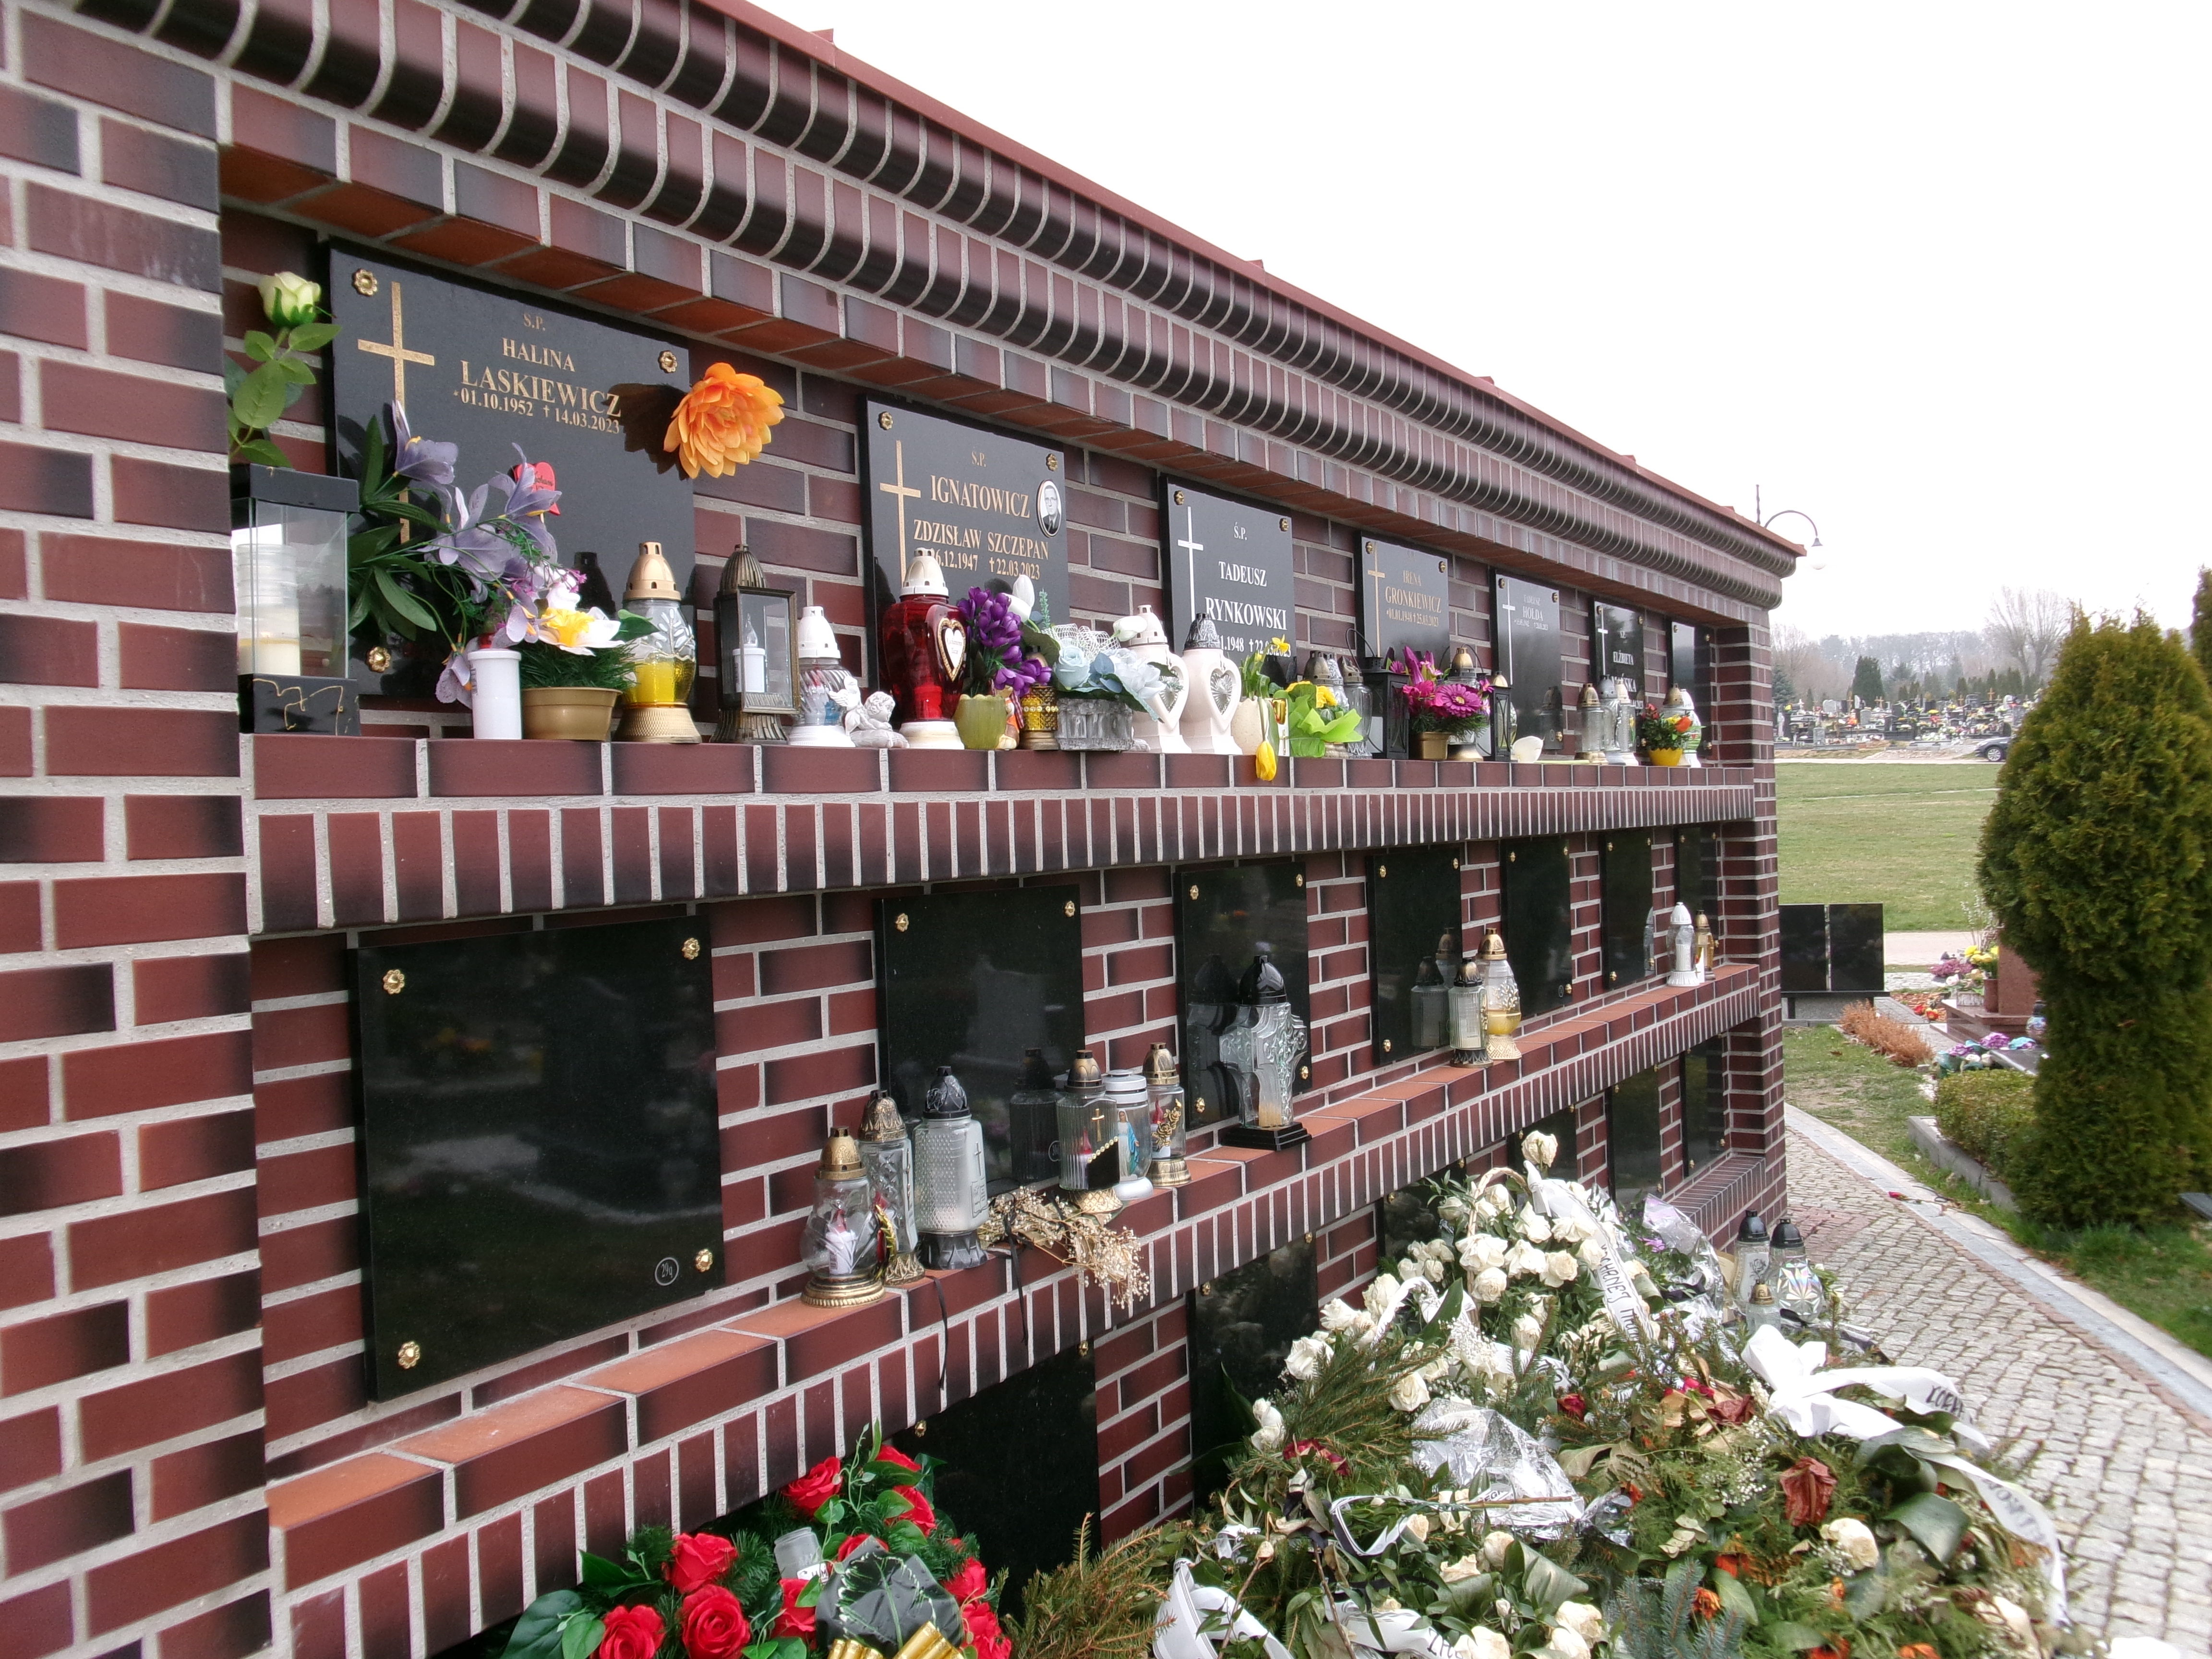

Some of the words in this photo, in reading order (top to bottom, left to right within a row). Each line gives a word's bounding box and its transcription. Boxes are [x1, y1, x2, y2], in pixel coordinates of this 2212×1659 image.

[501, 337, 576, 373] HALINA
[460, 360, 622, 418] LASKIEWICZ
[930, 475, 1031, 519] IGNATOWICZ
[914, 519, 982, 550] ZDZISŁAW
[987, 531, 1049, 560] SZCZEPAN
[1233, 522, 1248, 541] Ś.P.
[1218, 561, 1267, 588] TADEUSZ
[1403, 570, 1421, 587] IRENA
[1204, 597, 1287, 631] RYNKOWSKI
[1385, 586, 1442, 613] GRONKIEWICZ
